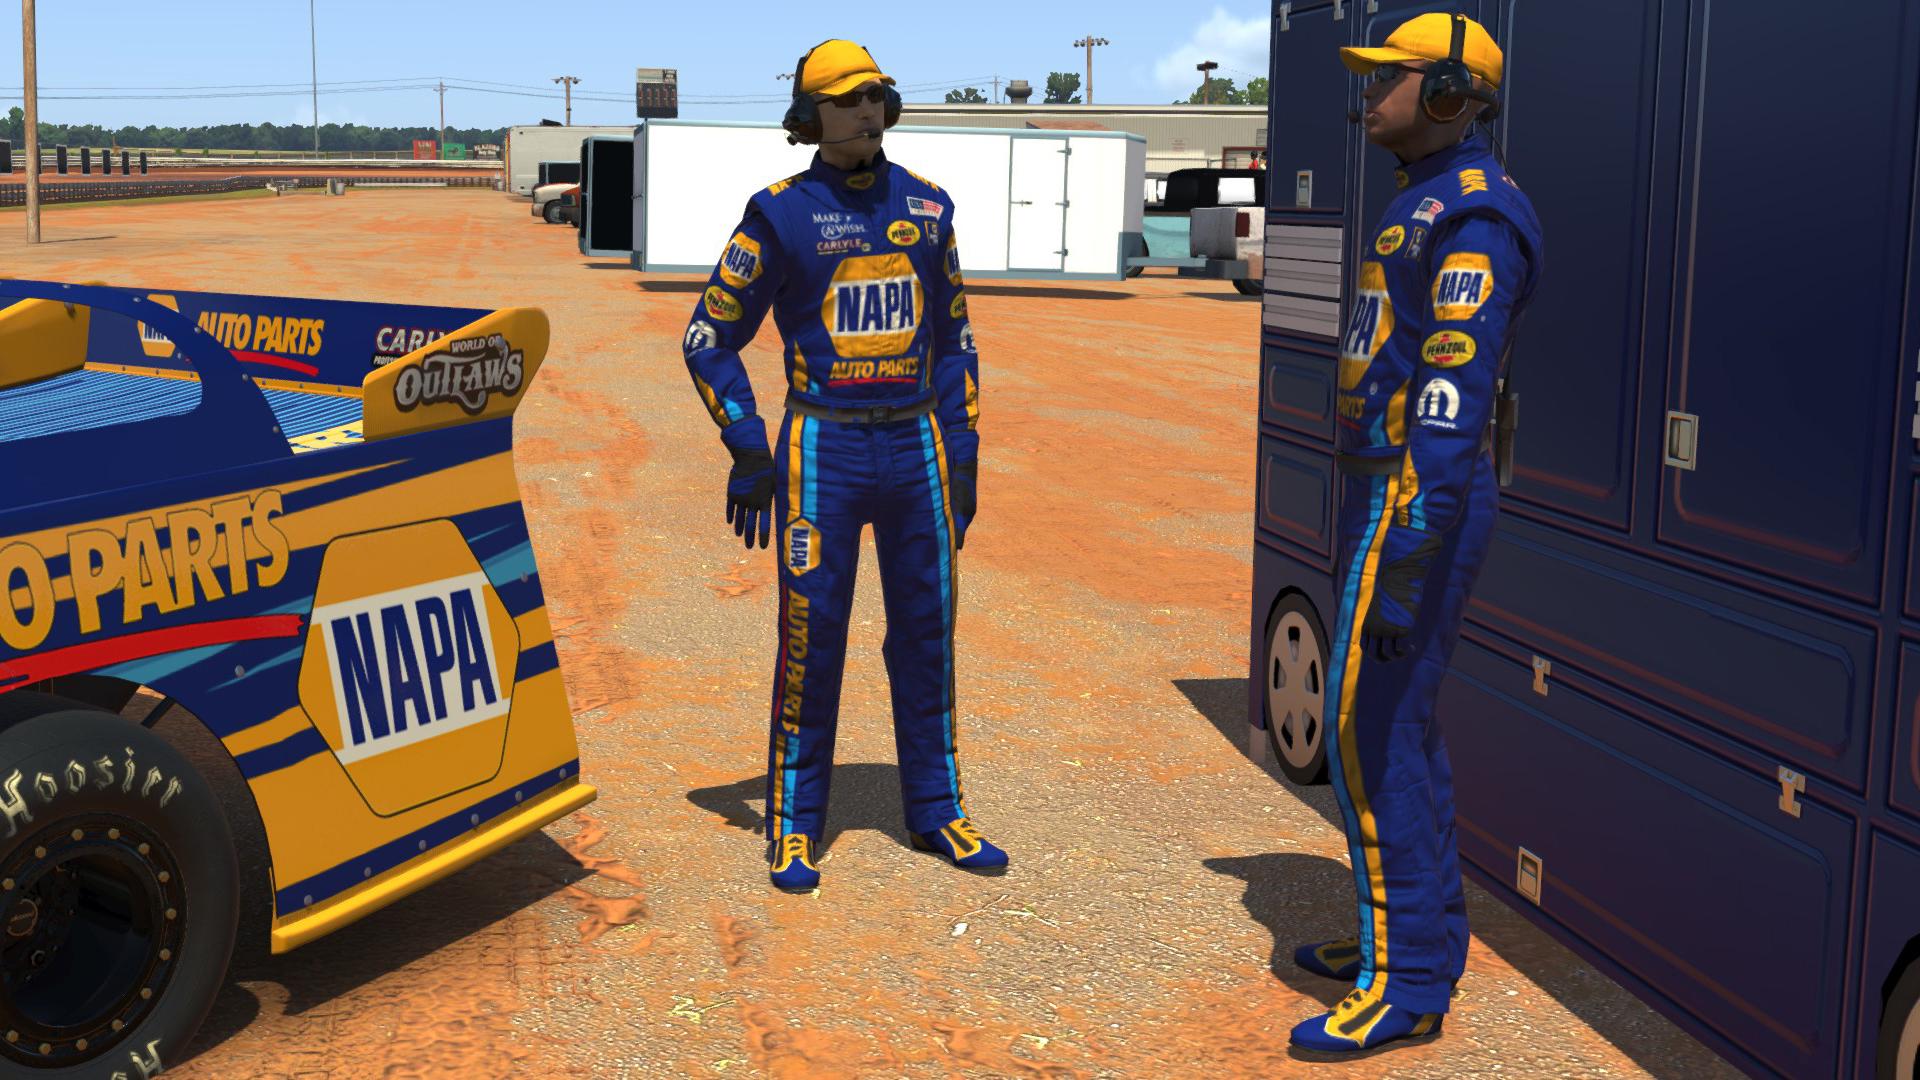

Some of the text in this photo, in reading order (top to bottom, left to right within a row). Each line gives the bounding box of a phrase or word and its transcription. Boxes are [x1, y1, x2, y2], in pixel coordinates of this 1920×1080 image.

[723, 241, 758, 280] NAPA
[816, 239, 863, 250] CARLYLE
[838, 280, 915, 333] NAPA
[1436, 270, 1484, 305] NAPA
[252, 315, 325, 357] PARTS
[451, 337, 486, 353] WORLD
[1343, 294, 1380, 355] PA
[829, 357, 919, 379] AUTO PARTS
[66, 489, 291, 635] PARTS
[791, 527, 810, 568] NAPA
[330, 588, 498, 747] NAPA
[781, 588, 810, 736] AUTO PARTS
